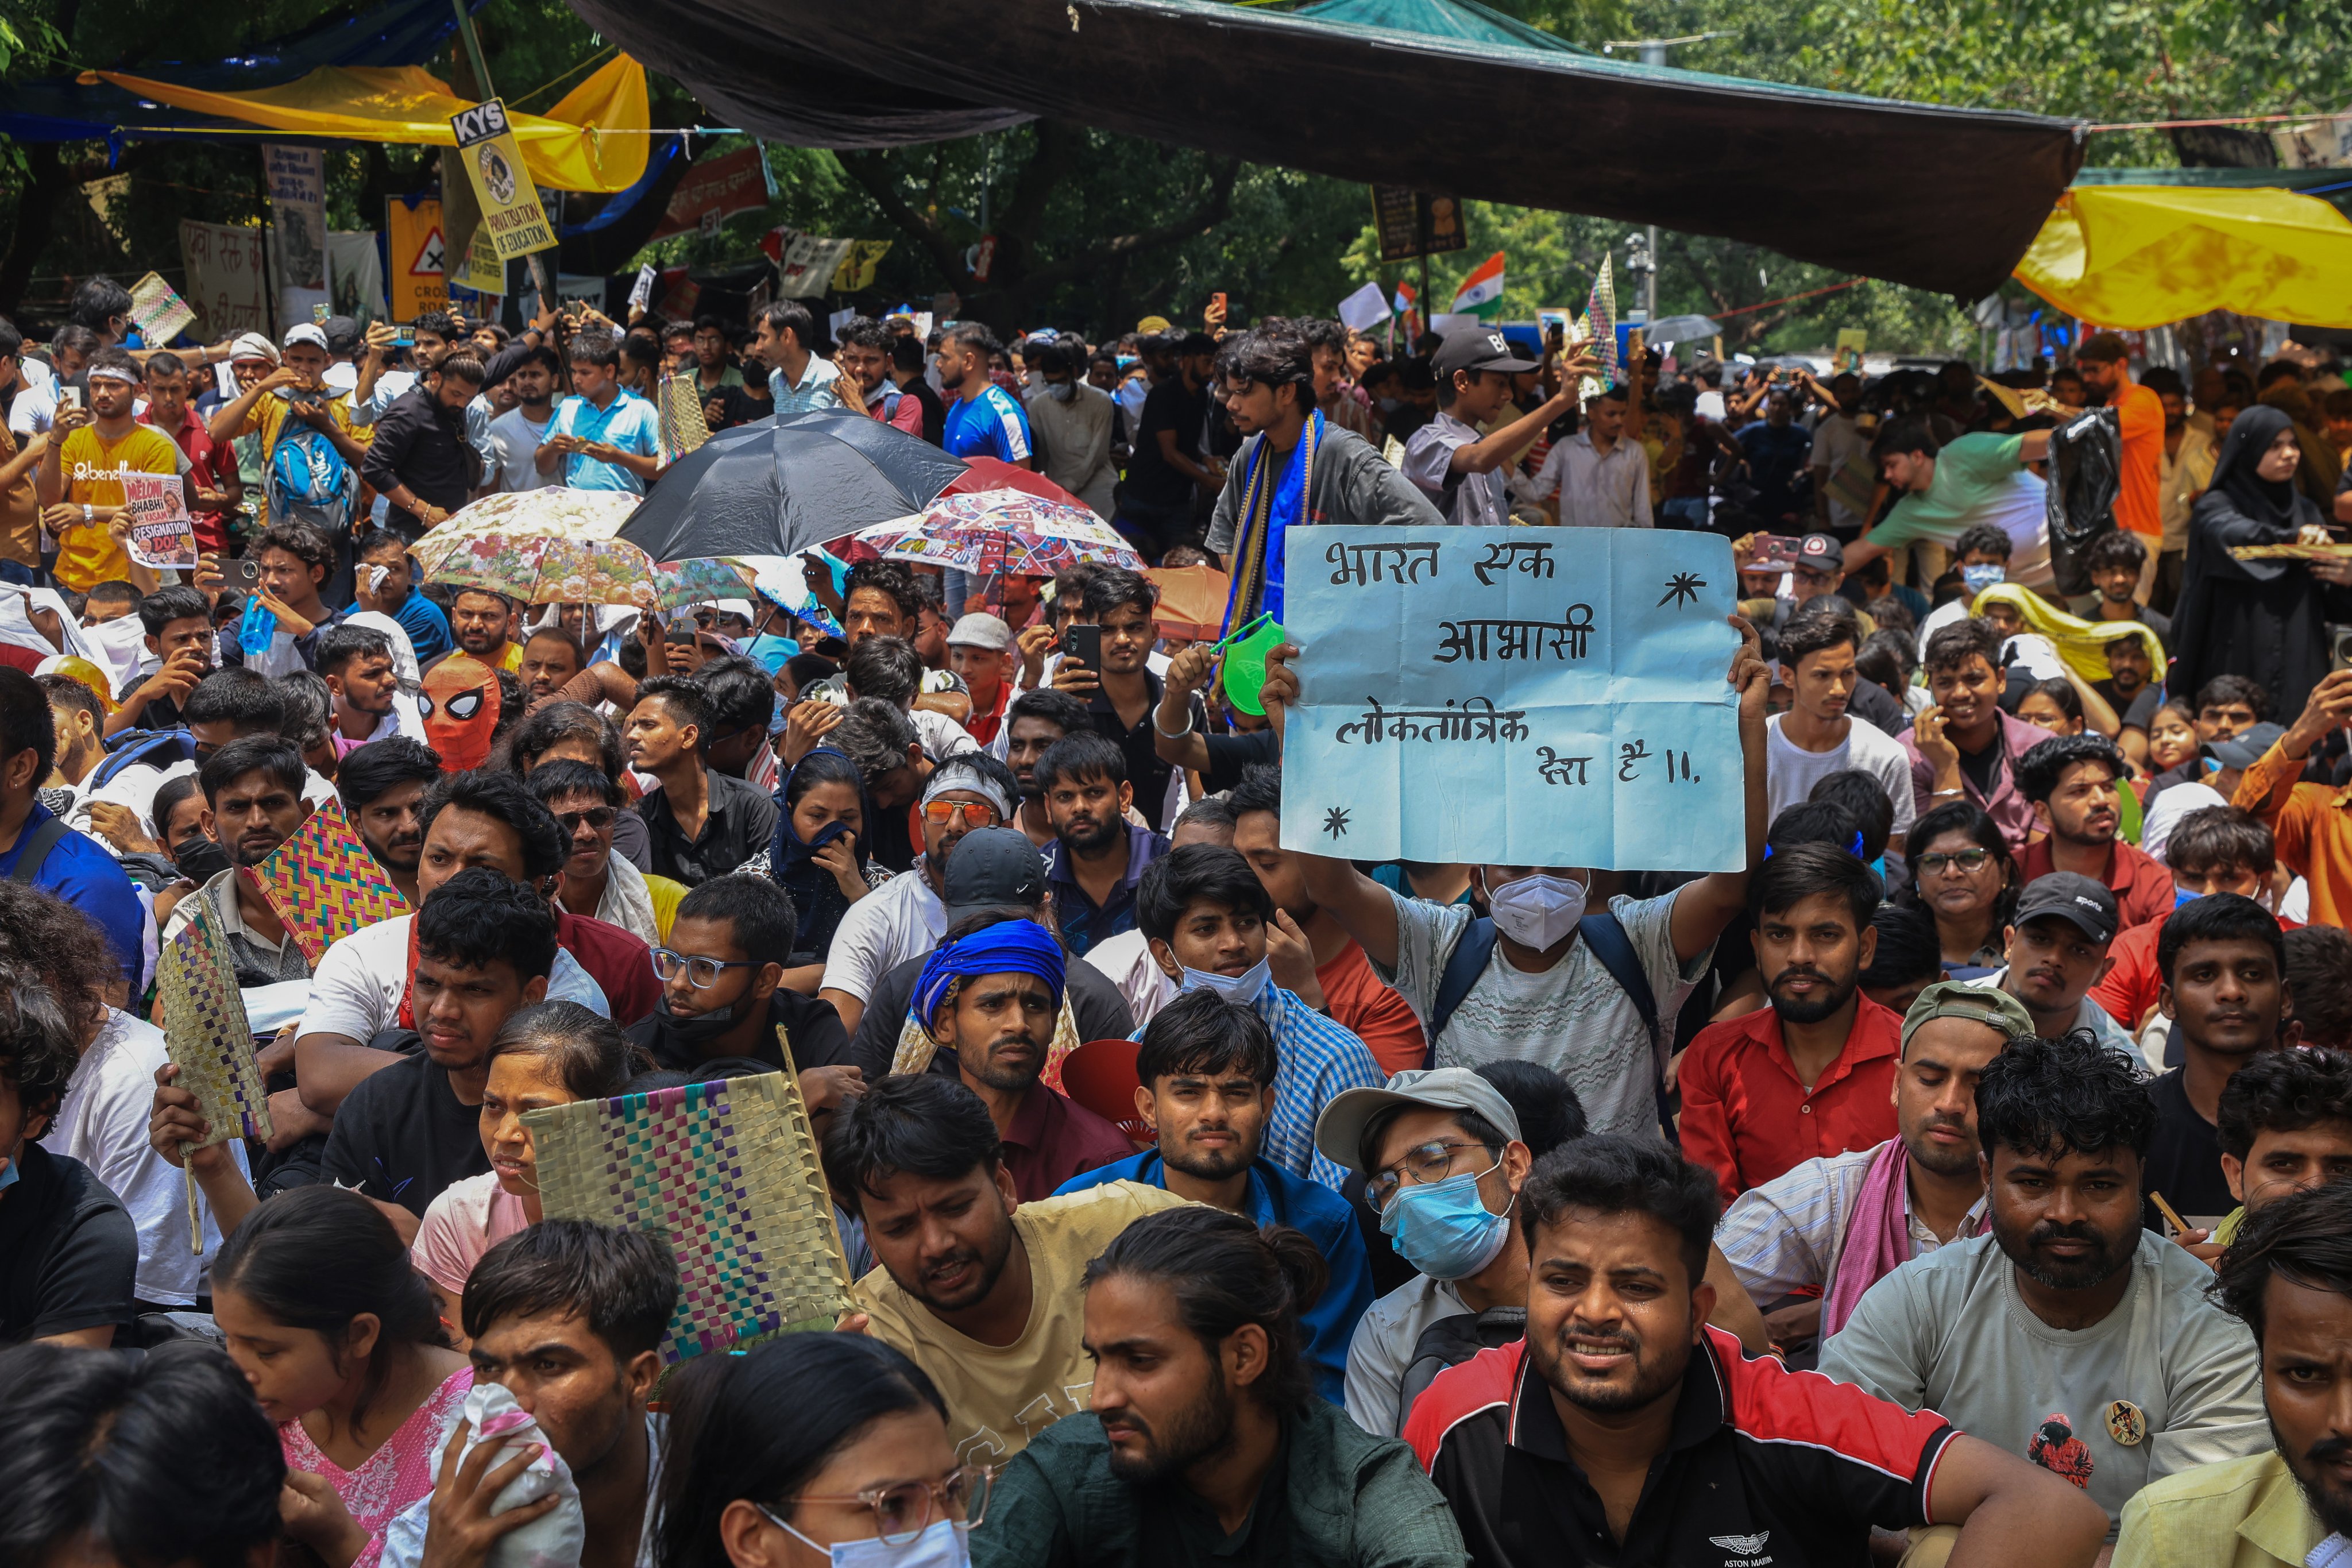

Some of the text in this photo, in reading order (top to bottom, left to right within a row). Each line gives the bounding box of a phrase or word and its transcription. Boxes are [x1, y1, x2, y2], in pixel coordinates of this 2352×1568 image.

[453, 102, 505, 142] KYS
[480, 145, 492, 170] NO!
[488, 202, 542, 234] PRIVATISATION
[496, 234, 506, 254] OF
[505, 223, 549, 252] EDUCATION
[314, 450, 332, 486] Nike
[126, 480, 163, 503] MELONI
[132, 522, 189, 541] RESIGNATION
[145, 511, 168, 522] KASAM
[153, 535, 176, 552] DO!
[1326, 542, 1554, 586] भारत एक
[1434, 604, 1595, 663] आभासी
[1337, 696, 1529, 744] लोकतांत्रिक
[1536, 746, 1594, 785] देश
[1618, 739, 1654, 782] है
[2075, 896, 2102, 912] sports
[1751, 1555, 1773, 1567] MARTIN
